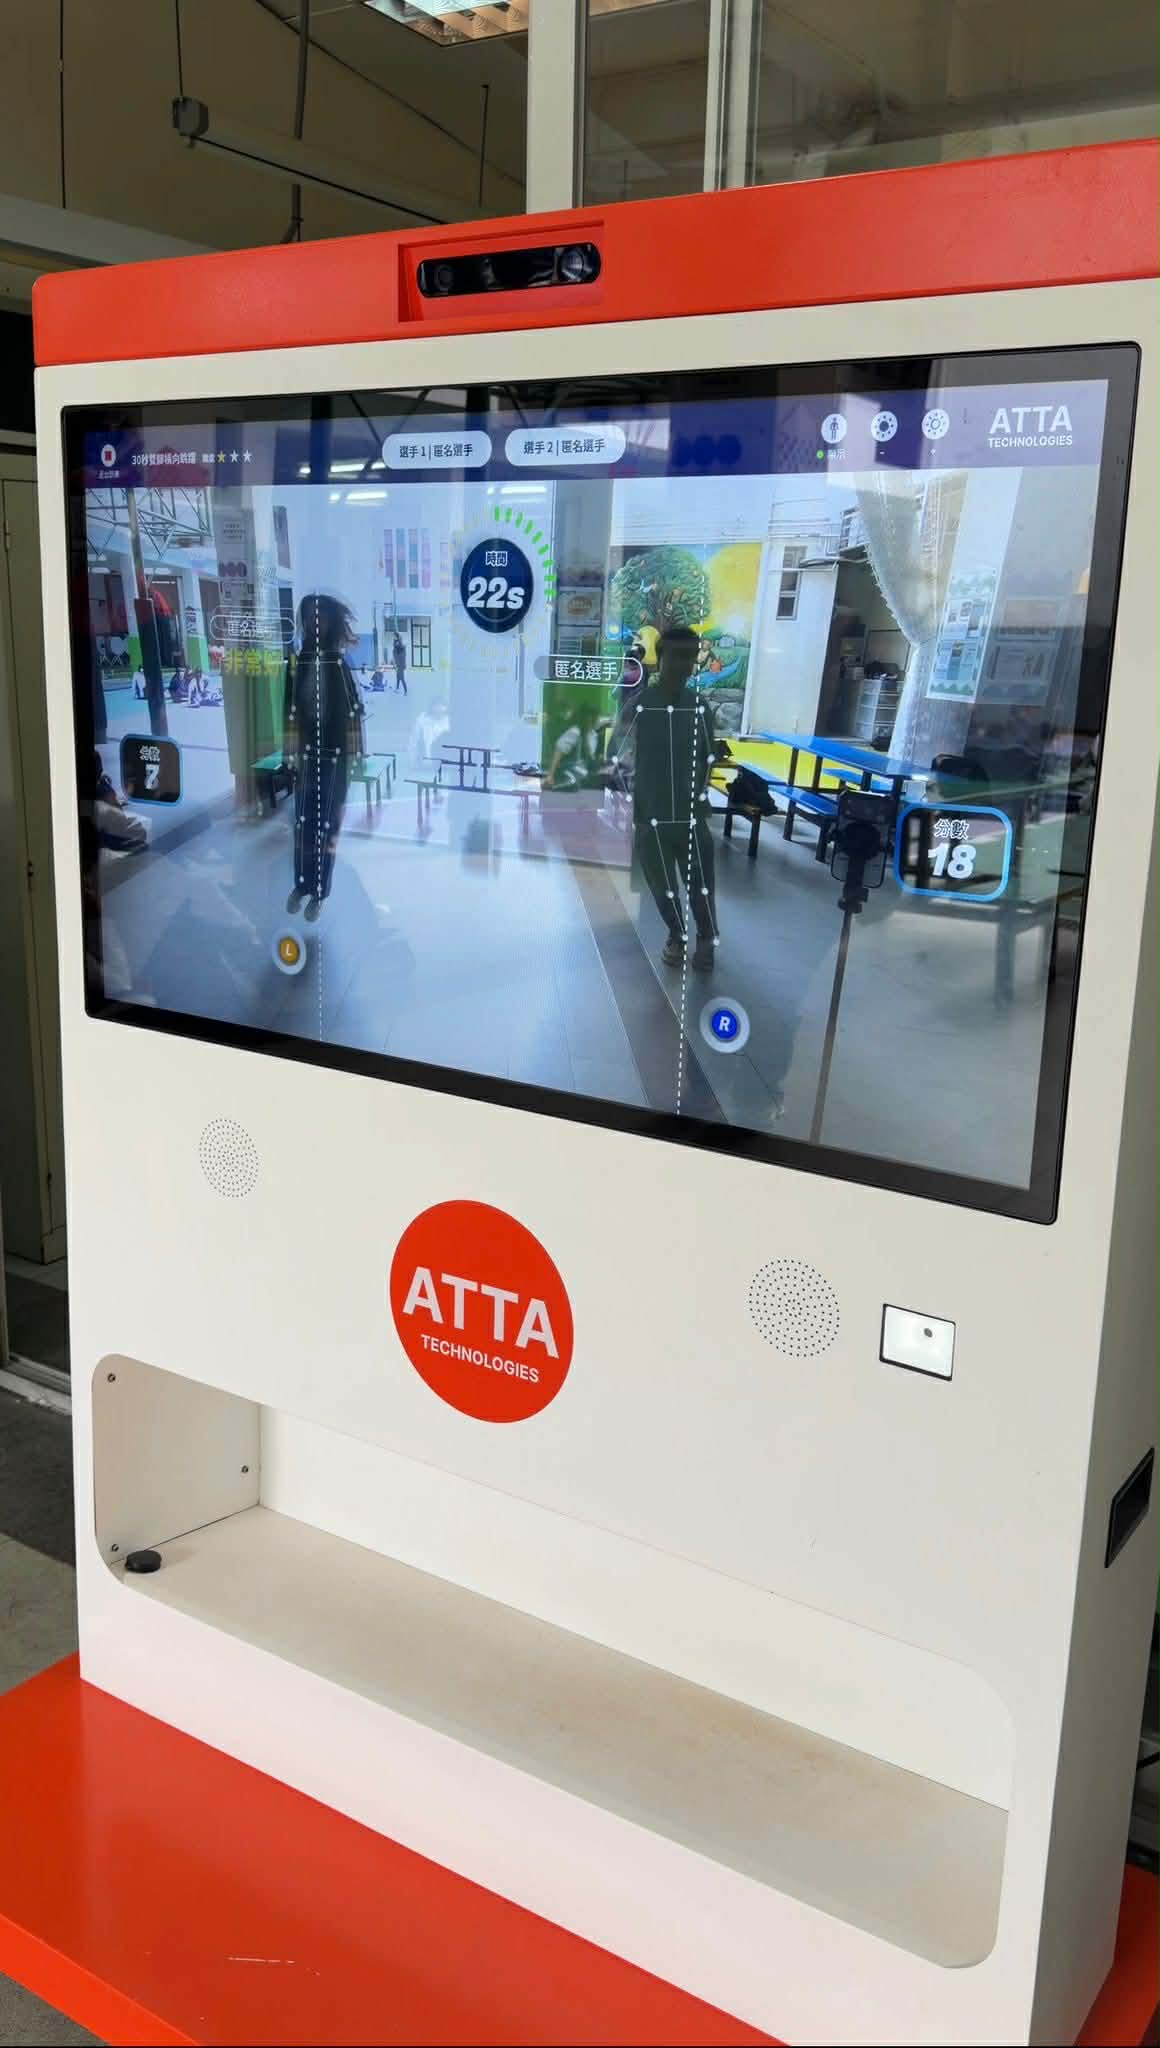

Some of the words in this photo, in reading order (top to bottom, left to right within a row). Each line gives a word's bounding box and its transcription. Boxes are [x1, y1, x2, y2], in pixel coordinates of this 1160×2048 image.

[989, 405, 1073, 434] ATTA
[433, 443, 473, 458] 匿名選手
[561, 438, 605, 454] 匿名選手
[988, 435, 1073, 449] TECHNOLOGIES
[485, 550, 508, 567] 時間
[467, 576, 525, 609] 22s
[554, 660, 618, 681] 匿名選手
[933, 818, 970, 840] 分數
[927, 842, 977, 879] 18
[719, 1015, 731, 1032] R
[402, 1266, 560, 1359] ATTA
[421, 1334, 540, 1383] TECHNOLOGIES
